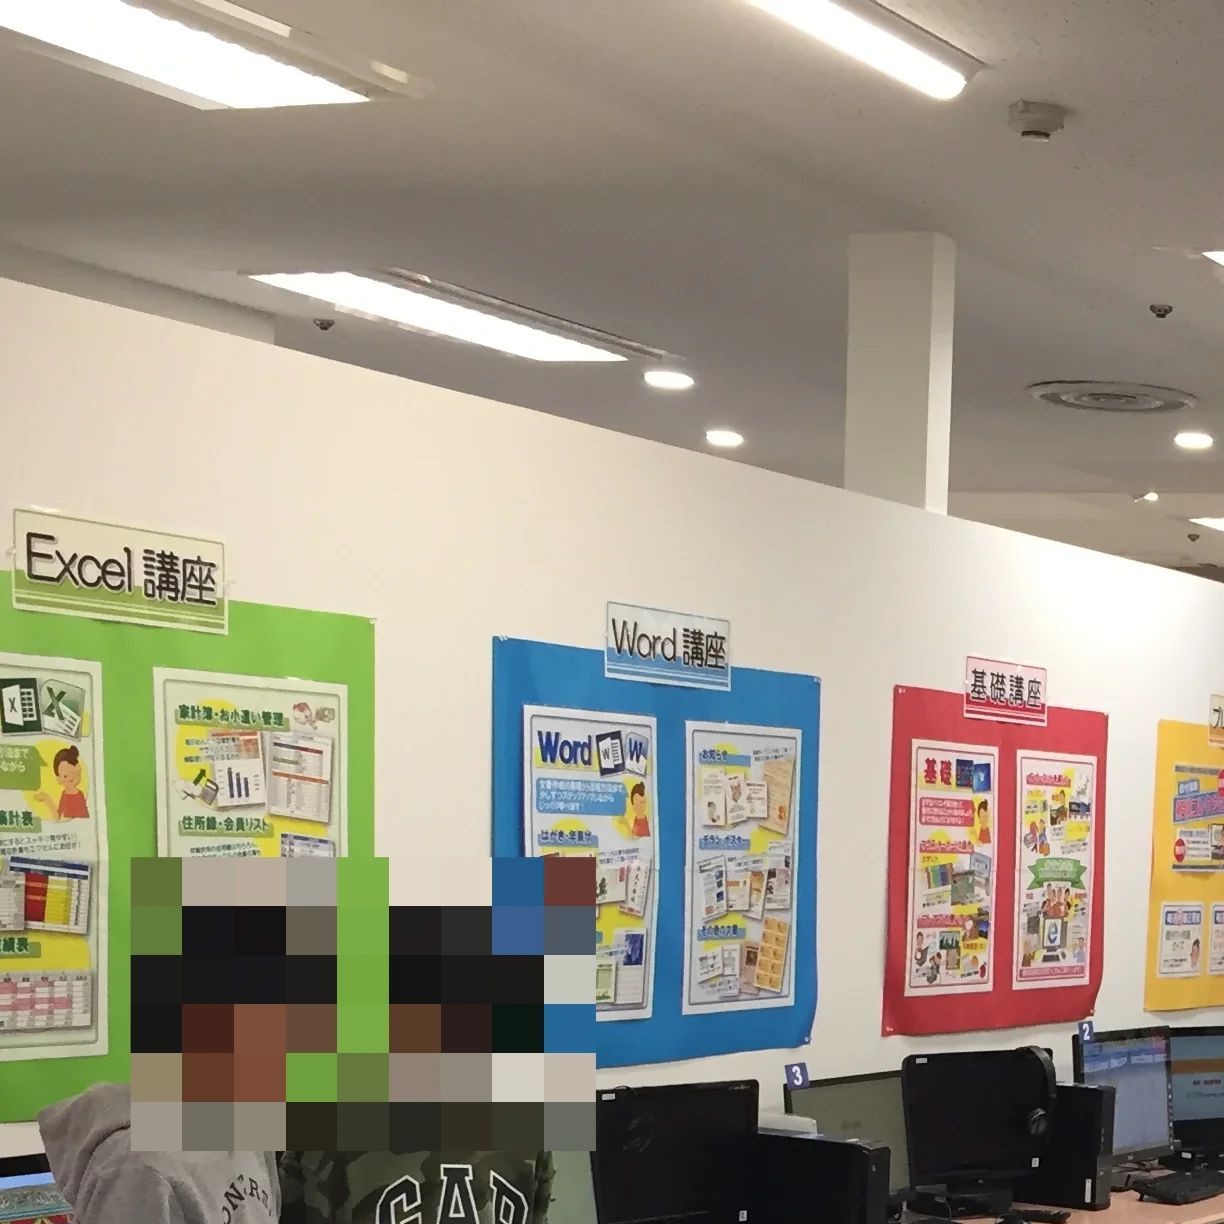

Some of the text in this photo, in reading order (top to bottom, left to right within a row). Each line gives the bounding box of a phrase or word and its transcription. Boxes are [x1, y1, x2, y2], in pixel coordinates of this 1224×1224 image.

[26, 532, 217, 606] Excel 講座
[612, 618, 727, 670] Word 講座
[970, 668, 1042, 708] 基礎講座
[537, 730, 592, 766] Word
[924, 758, 952, 786] 基礎
[1083, 1023, 1091, 1041] 2
[791, 1066, 803, 1085] 3
